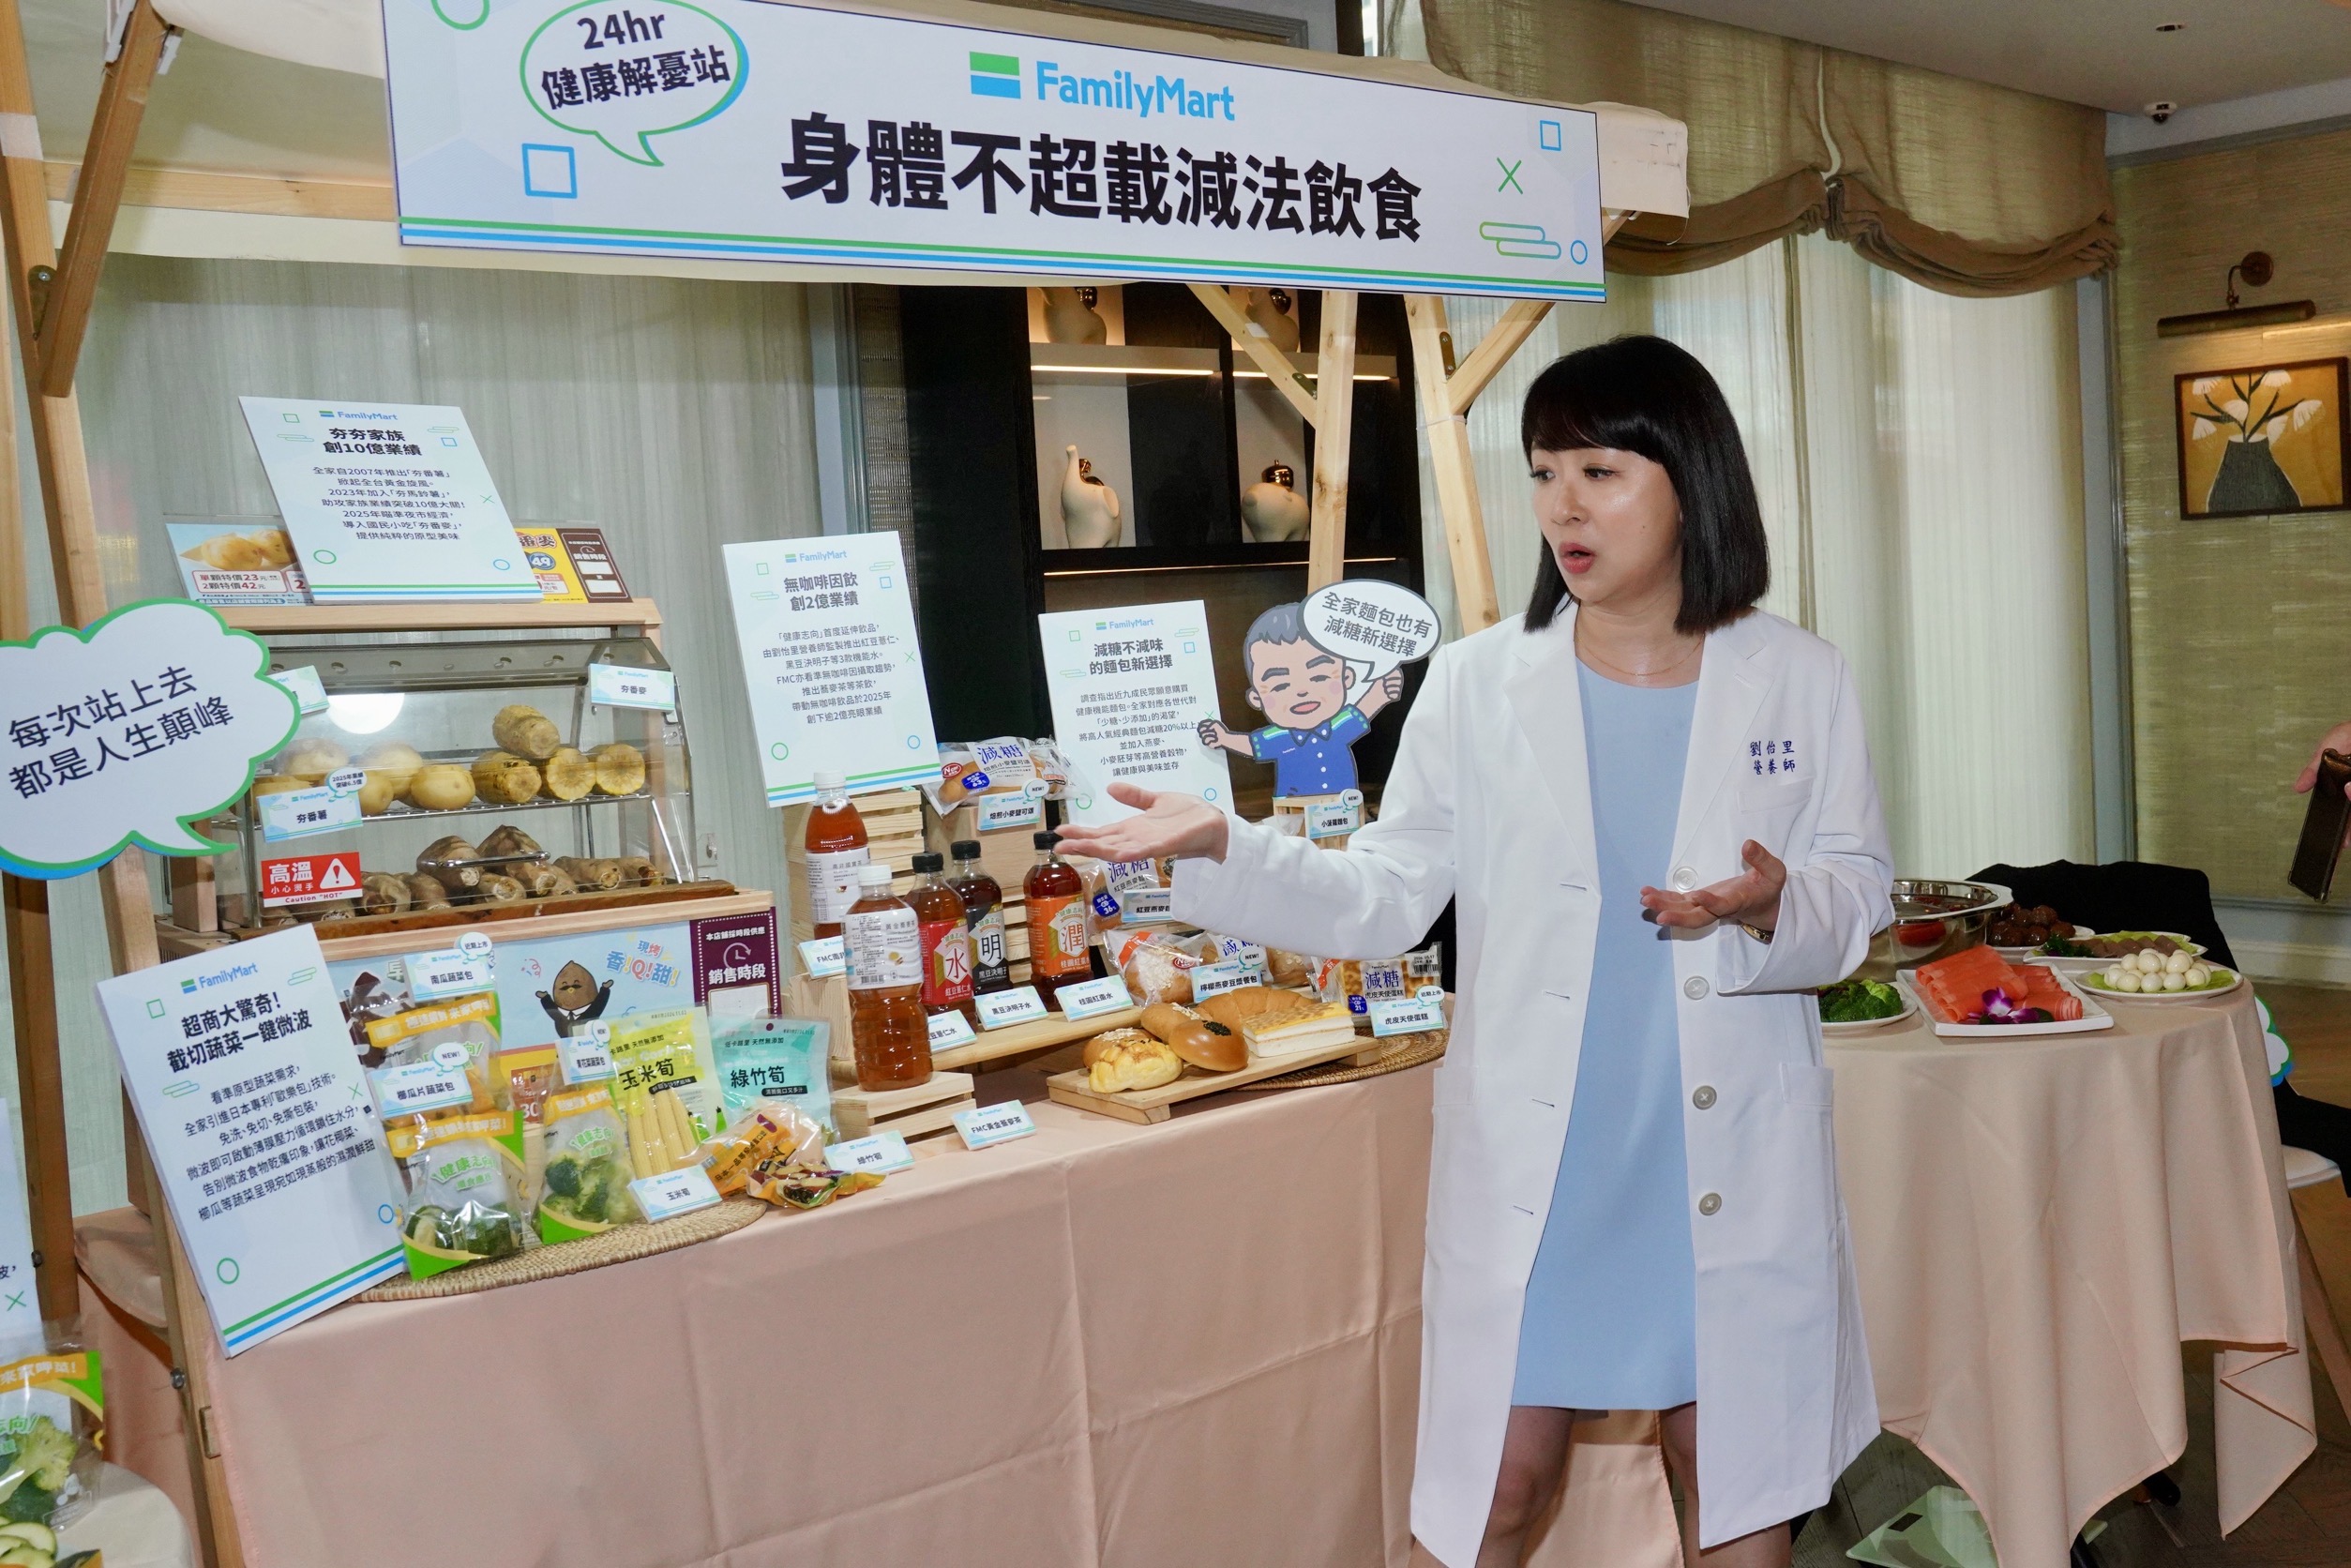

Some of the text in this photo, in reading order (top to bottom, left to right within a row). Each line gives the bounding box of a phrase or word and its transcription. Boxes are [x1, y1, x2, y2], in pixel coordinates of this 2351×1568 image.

[576, 8, 666, 50] 24hr
[541, 45, 731, 111] 健康解憂站
[1036, 60, 1236, 121] FamilyMart
[780, 112, 1423, 243] 身體不超載減法飲食
[338, 411, 398, 421] FamilyMart
[329, 428, 406, 442] 夯夯家族
[324, 442, 422, 457] 創10億業績
[531, 557, 550, 566] 49
[799, 550, 847, 562] FamilyMart
[784, 572, 858, 594] 無咖啡因飲
[791, 591, 859, 611] 創2億業績
[1109, 618, 1153, 628] FamilyMart
[1321, 591, 1432, 639] 全家麵包也有
[1324, 615, 1418, 657] 減糖新選擇
[1093, 639, 1164, 657] 減糖不減味
[1089, 655, 1173, 675] 的麵包新選擇
[621, 685, 647, 695] 夯番麥
[8, 666, 197, 749] 每次站上去
[9, 695, 234, 799] 都是人生顛峰
[977, 745, 1023, 764] 減糖
[1750, 741, 1795, 756] 劉怡里
[1754, 758, 1795, 775] 營養師
[296, 810, 327, 823] 夯番薯
[269, 861, 313, 884] 高溫
[285, 895, 316, 903] Caution
[1062, 924, 1084, 952] 潤
[638, 940, 661, 957] 現烤
[982, 934, 1002, 962] 明
[946, 948, 967, 978] 水
[200, 962, 258, 988] FamilyMart
[430, 972, 474, 985] 南瓜蔬菜包
[708, 963, 766, 985] 銷售時段
[1365, 971, 1399, 988] 減糖
[1365, 989, 1404, 999] 虎皮天使蛋糕
[181, 991, 281, 1039] 超商大驚奇！
[1385, 1013, 1428, 1025] 虎皮天使蛋糕
[167, 1009, 312, 1073] 截切蔬菜一鍵微波
[929, 1028, 957, 1040] 豆薏仁水
[619, 1058, 673, 1090] 玉米筍
[731, 1065, 784, 1088] 綠竹筍
[397, 1082, 455, 1100] 櫛瓜片蔬菜包
[666, 1188, 691, 1201] 玉米筍
